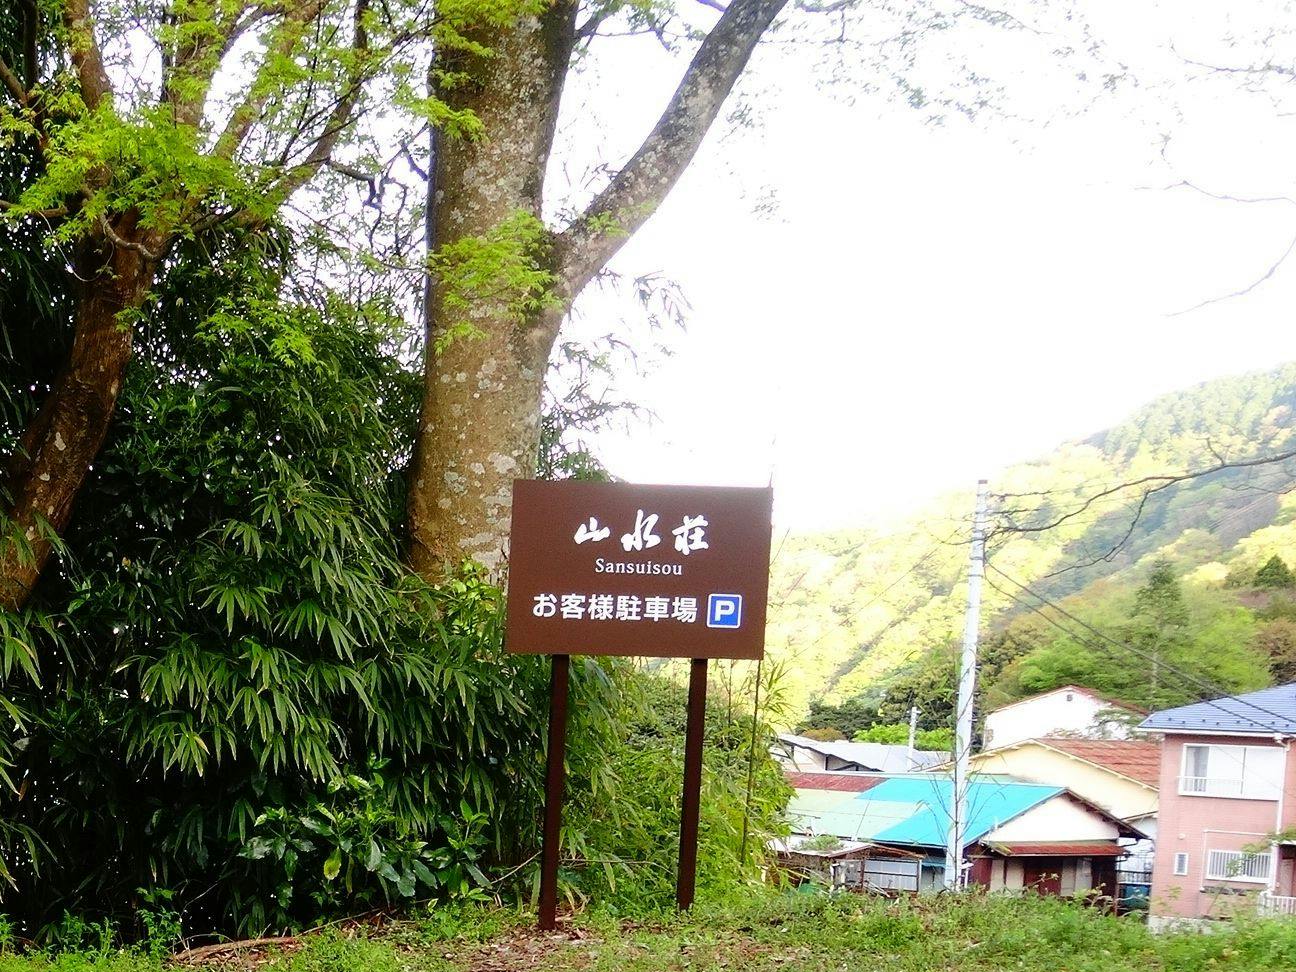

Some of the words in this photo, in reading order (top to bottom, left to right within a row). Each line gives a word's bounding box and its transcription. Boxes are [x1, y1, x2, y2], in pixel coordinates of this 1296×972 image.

[573, 509, 709, 556] 山水荘
[595, 558, 683, 576] Sansuisou
[532, 593, 698, 623] お客様駐車場
[713, 598, 736, 623] P
